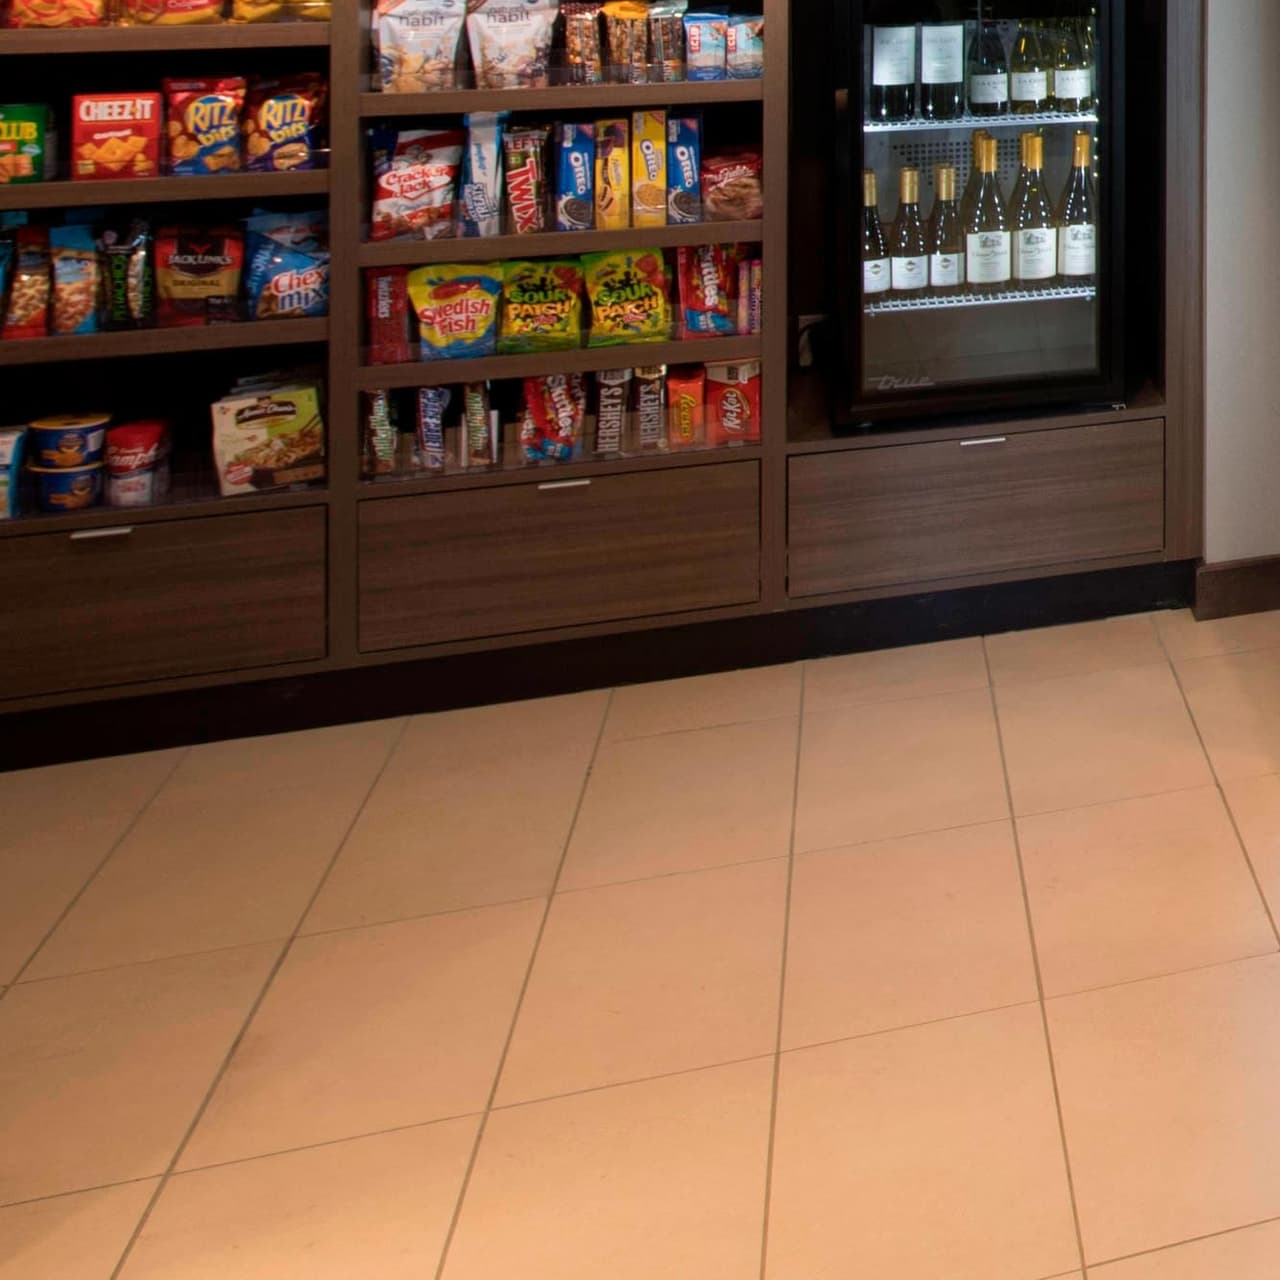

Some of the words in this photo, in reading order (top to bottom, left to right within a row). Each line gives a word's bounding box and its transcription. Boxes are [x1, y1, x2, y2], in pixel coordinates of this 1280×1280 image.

[191, 102, 235, 134] RITZ
[264, 100, 306, 131] RITZ
[569, 151, 587, 195] OREO
[641, 138, 658, 181] OREO
[675, 145, 693, 188] OREO
[386, 165, 453, 186] Cracker
[505, 157, 539, 234] TWIX
[272, 269, 327, 295] Chex
[510, 289, 568, 303] SOUR
[598, 284, 653, 305] SOUR
[418, 298, 492, 327] Swedish
[507, 303, 571, 319] PATCH
[596, 296, 658, 323] PATCH
[435, 316, 478, 337] Fish
[597, 387, 623, 453] HERSHEY'S
[639, 384, 660, 444] HERSHEY'S
